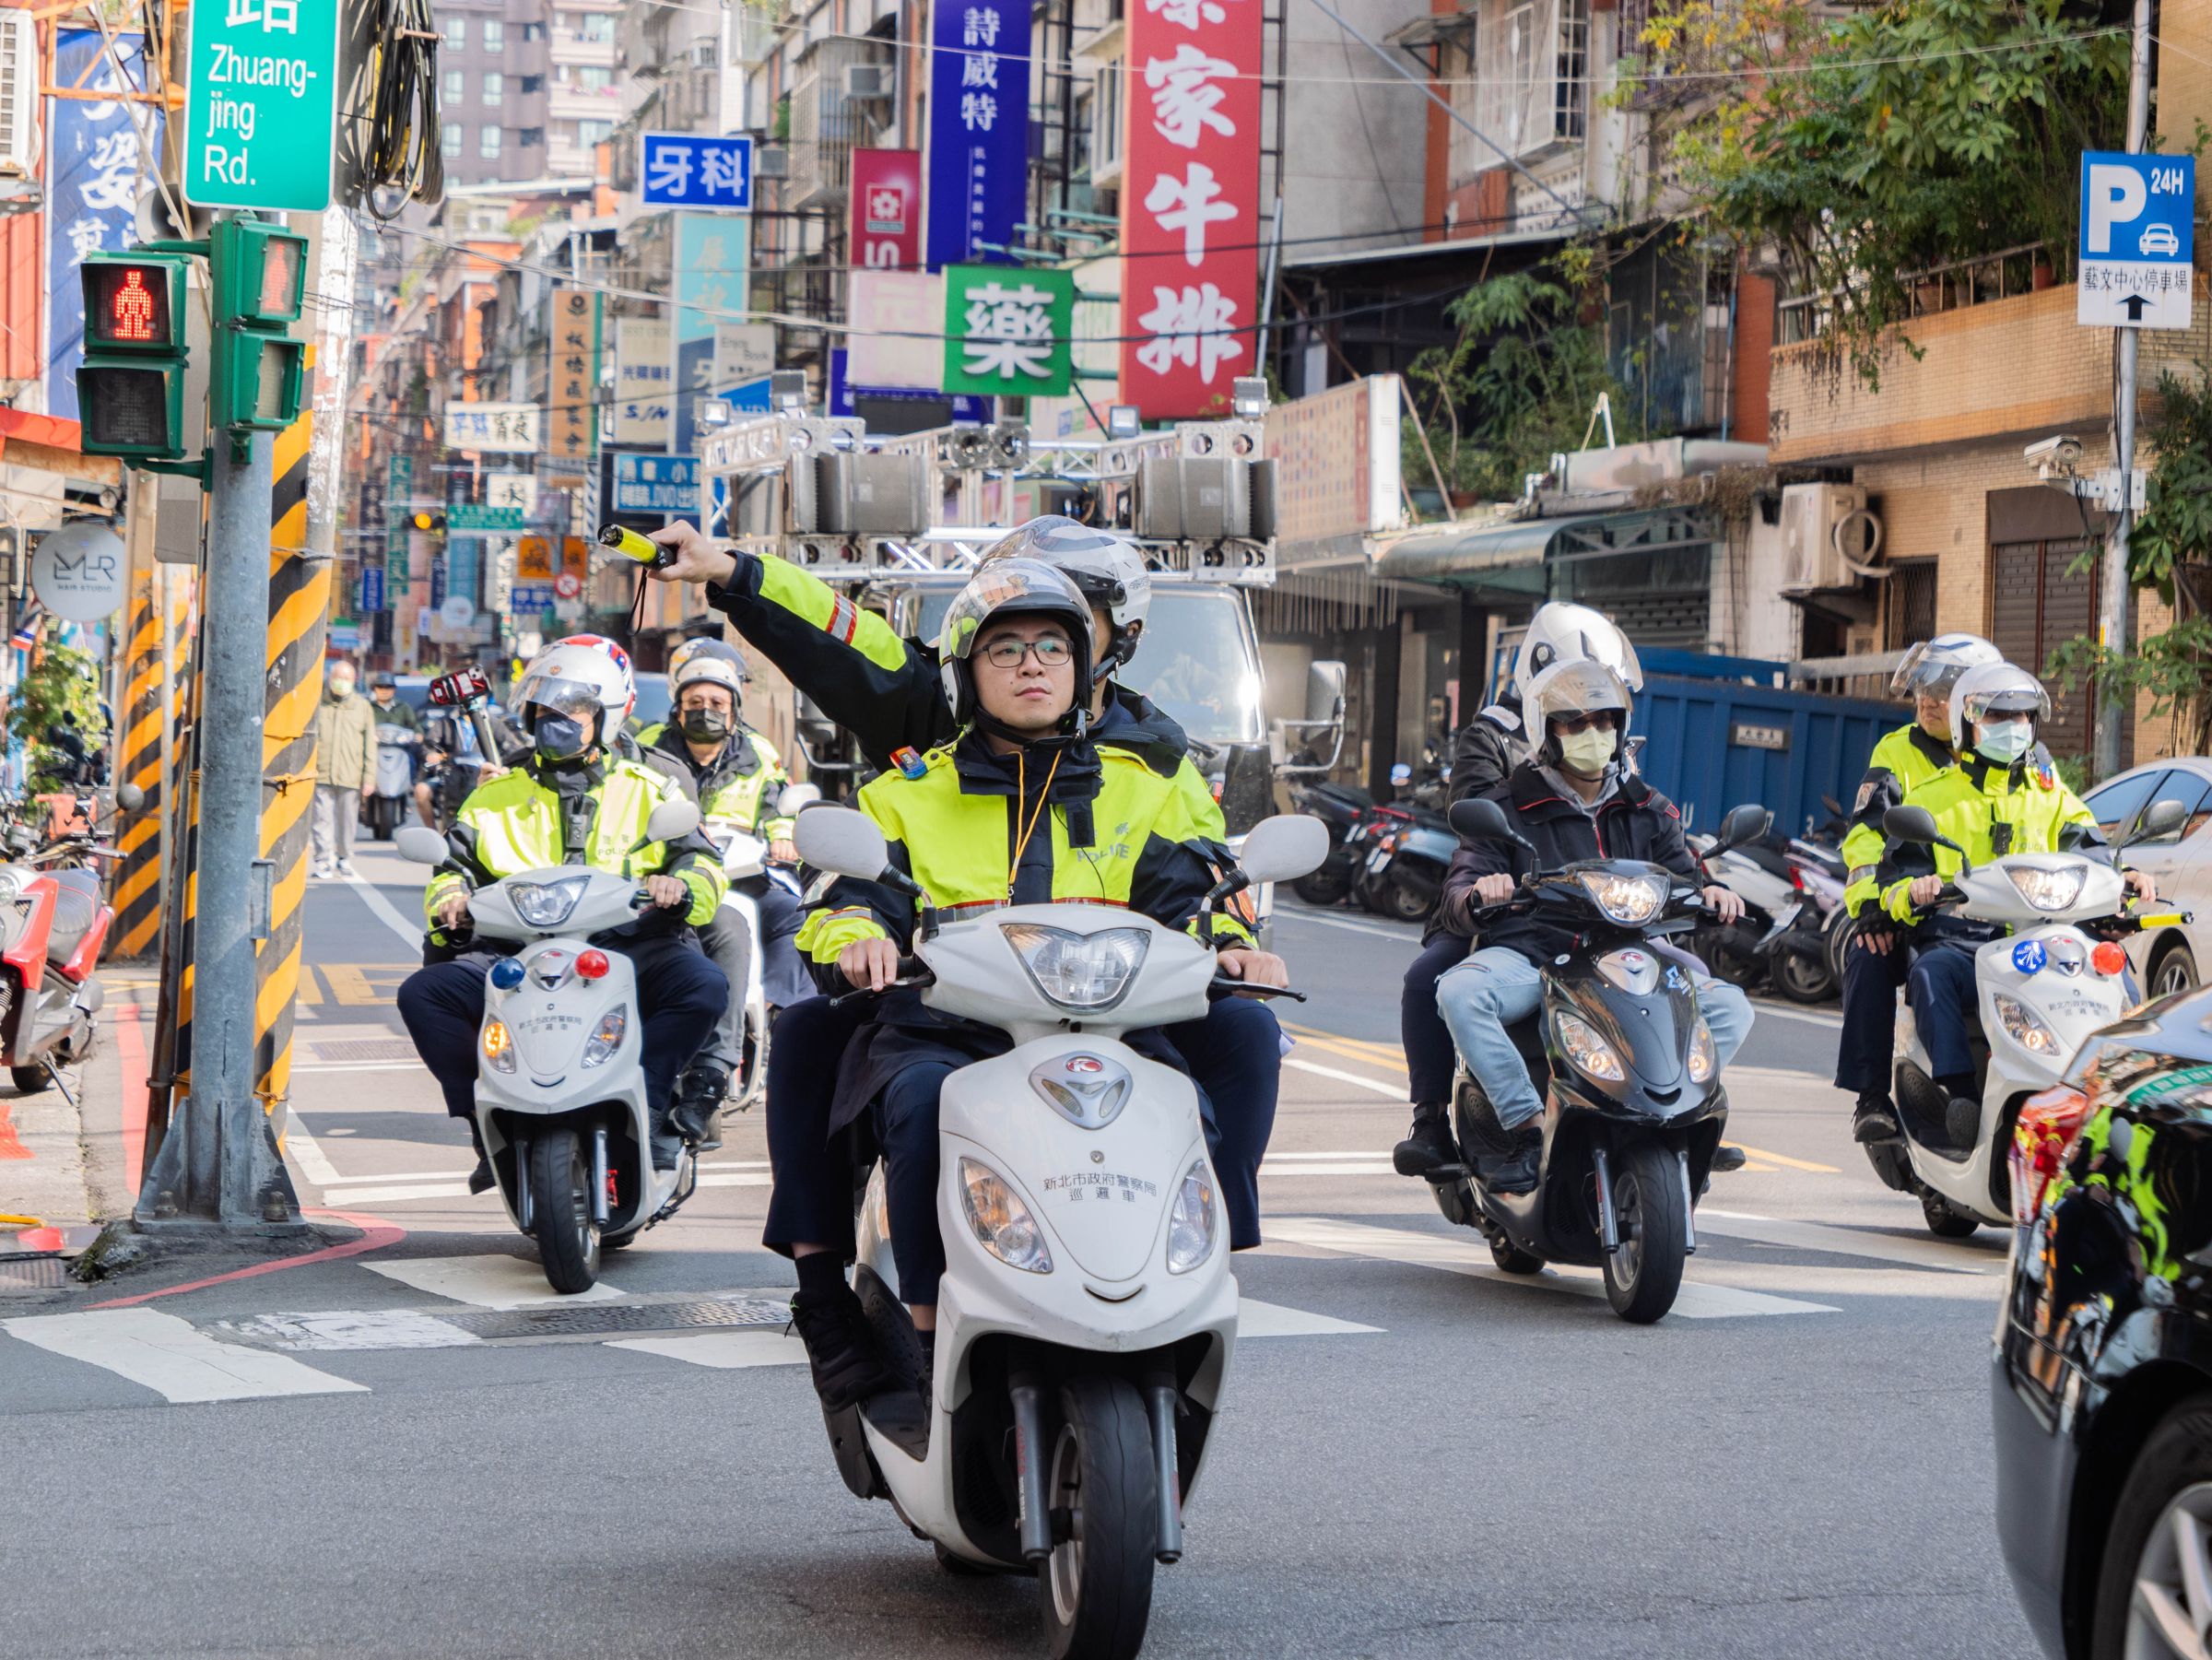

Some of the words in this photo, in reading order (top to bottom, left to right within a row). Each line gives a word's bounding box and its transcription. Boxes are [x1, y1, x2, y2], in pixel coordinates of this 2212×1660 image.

[207, 42, 317, 99] Zhuang-
[961, 6, 1001, 131] 詩威特
[206, 89, 255, 141] jing
[204, 144, 256, 186] Rd.
[648, 145, 746, 197] 牙科
[2150, 166, 2184, 195] 24H
[2088, 163, 2147, 253] P
[2083, 265, 2189, 294] 藝文中心停車場
[961, 282, 1055, 380] 藥
[1042, 1171, 1158, 1197] 新北市政府警察局
